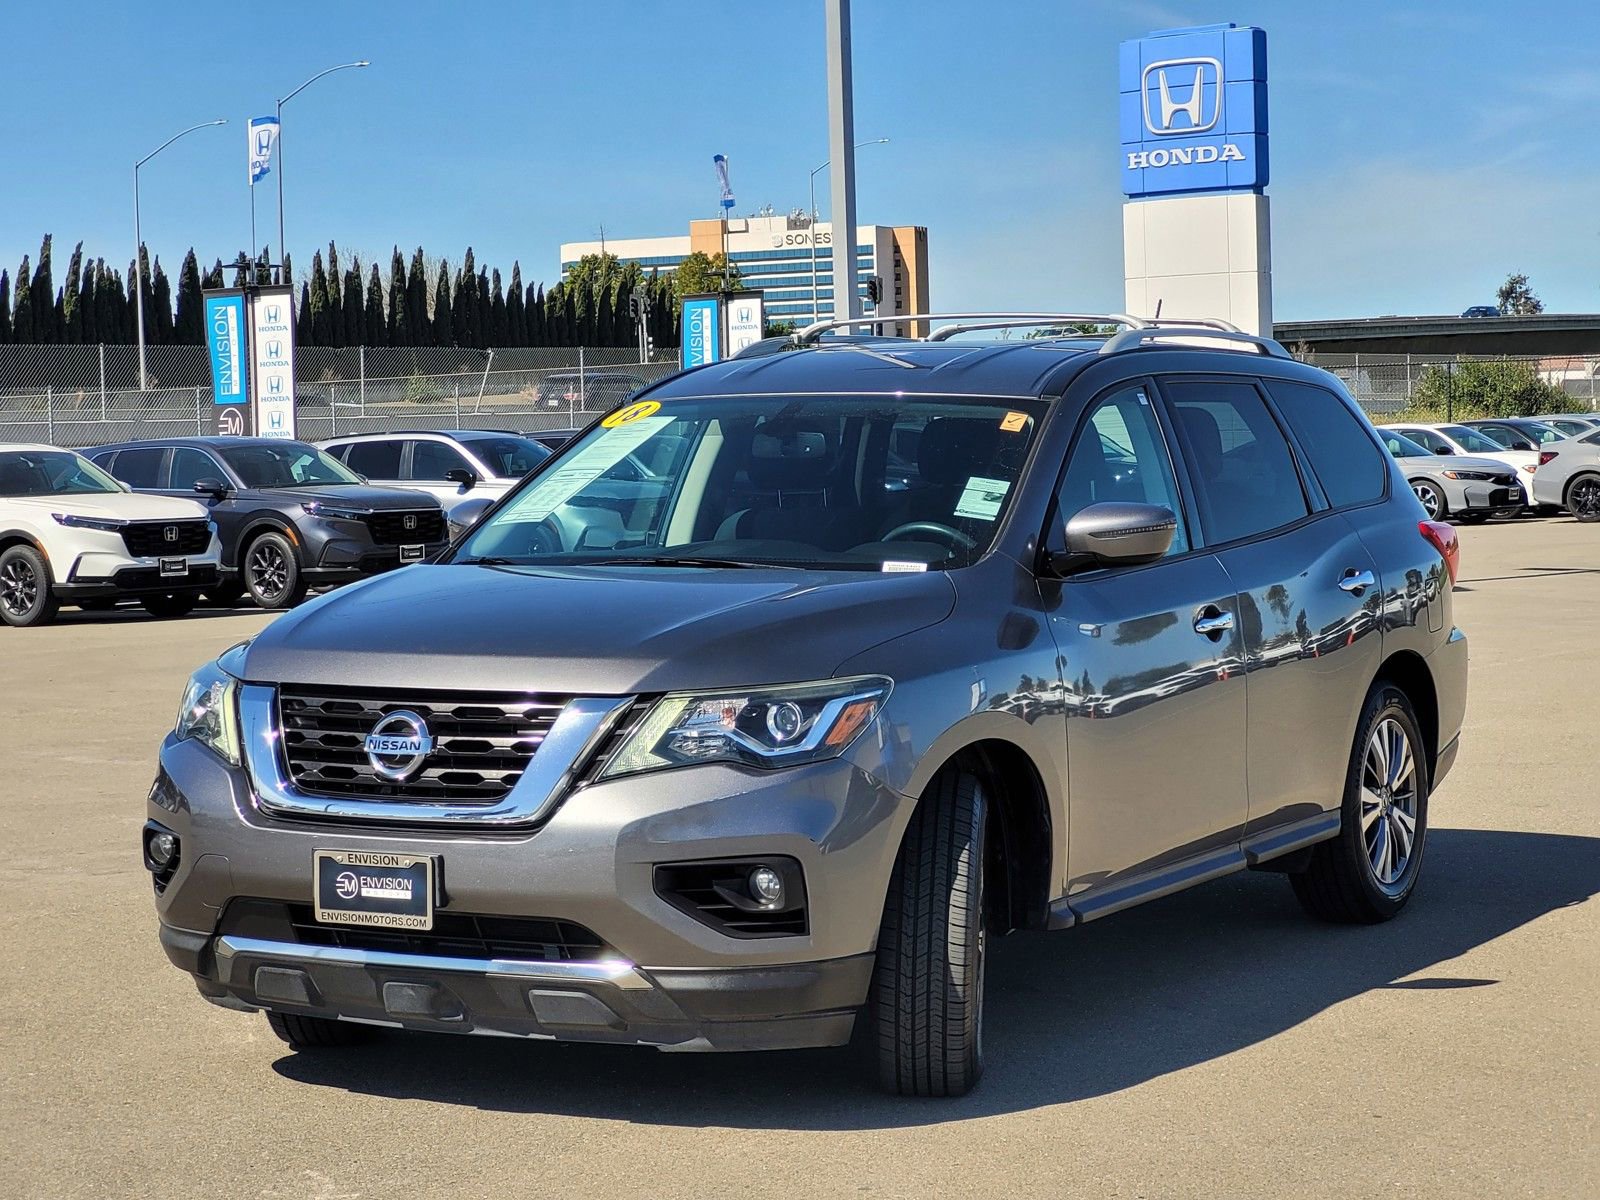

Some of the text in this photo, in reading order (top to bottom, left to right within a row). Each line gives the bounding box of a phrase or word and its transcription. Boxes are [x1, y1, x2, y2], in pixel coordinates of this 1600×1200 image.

[1127, 143, 1246, 169] HONDA
[785, 232, 832, 246] SONES
[258, 325, 289, 333] HONDA
[213, 305, 233, 396] ENVISION
[259, 360, 290, 368] HONDA
[260, 395, 291, 403] HONDA
[368, 739, 421, 751] NISSAN
[347, 853, 399, 866] ENVISION
[360, 876, 413, 890] ENVISION
[321, 911, 427, 928] ENVISIONMOTORS.COM
